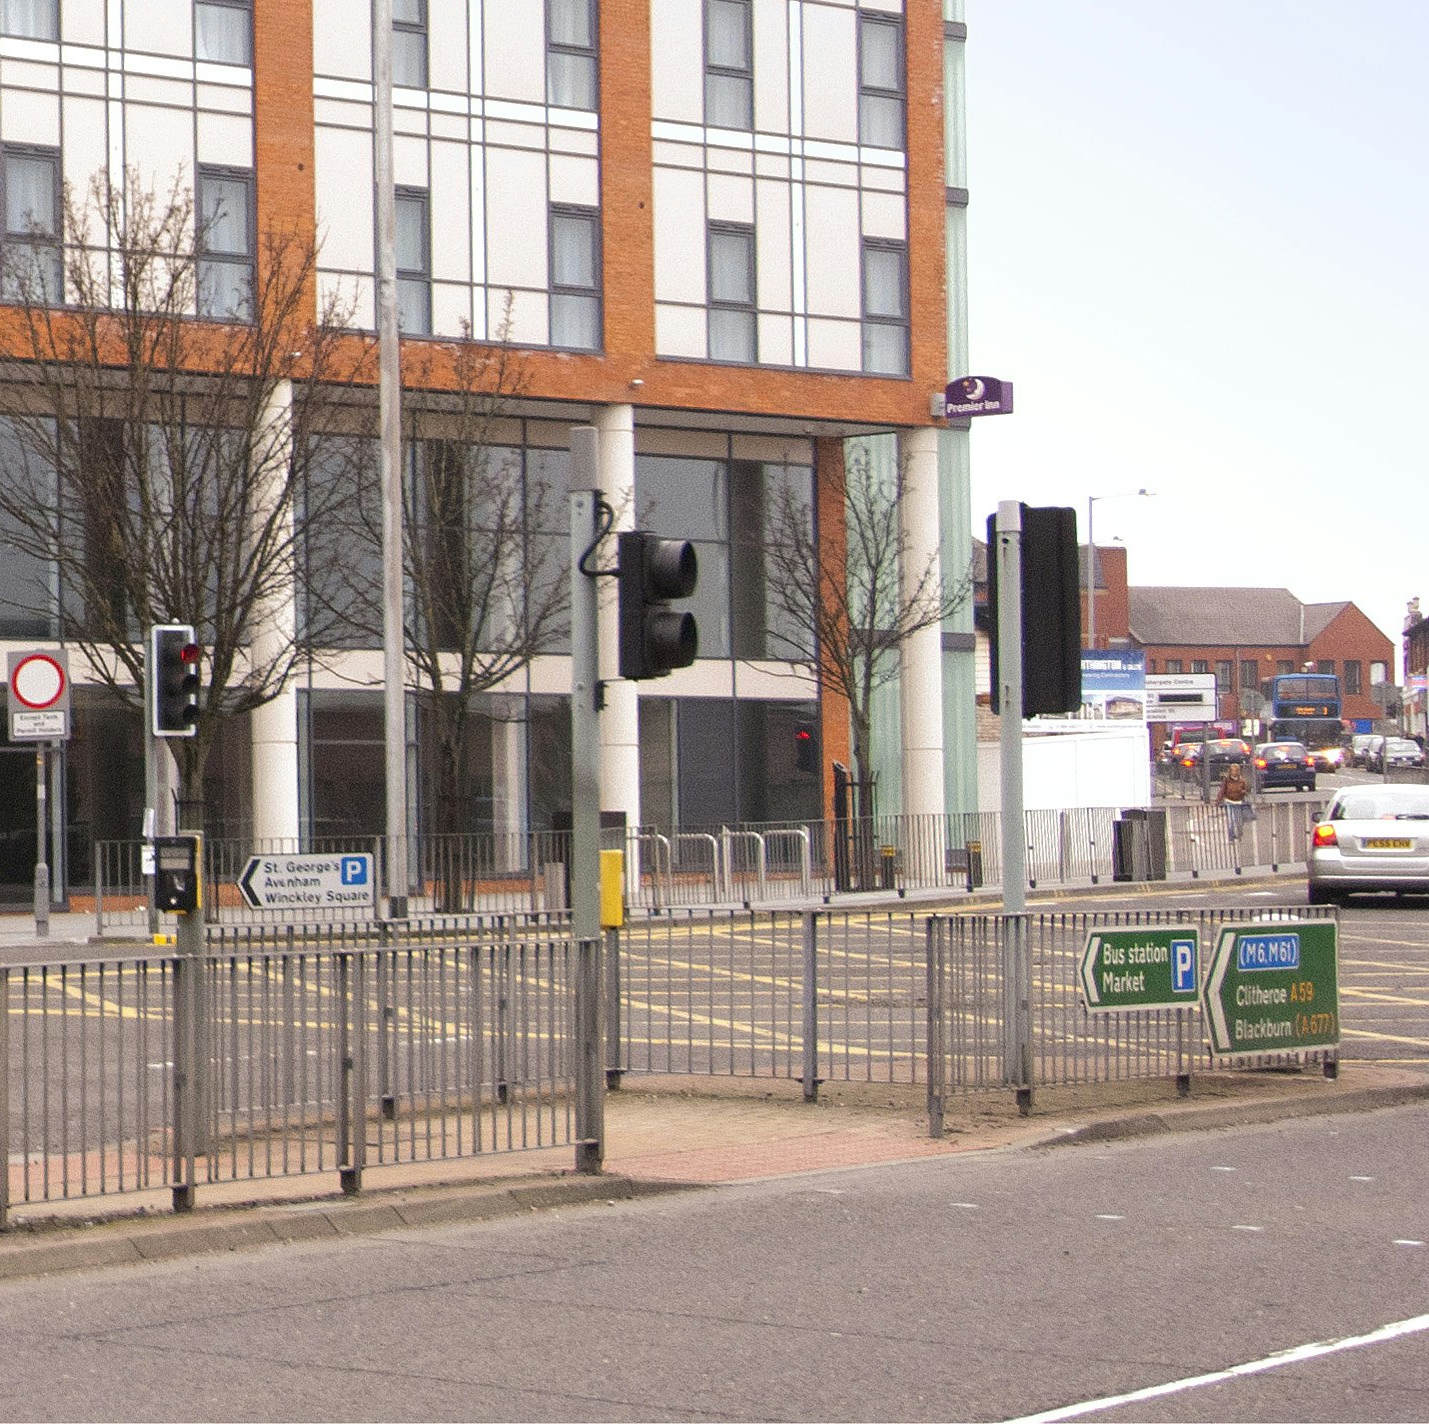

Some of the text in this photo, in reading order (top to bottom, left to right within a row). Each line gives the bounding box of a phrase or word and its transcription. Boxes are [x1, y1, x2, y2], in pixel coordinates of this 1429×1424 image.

[264, 860, 363, 883] St. George's P
[264, 876, 321, 888] Avenham
[264, 890, 370, 905] Winckley Square
[1102, 942, 1169, 966] Bus station
[1102, 944, 1192, 994] Market P
[1236, 984, 1288, 1007] Clitheroe
[1235, 1017, 1292, 1041] Blackburn
